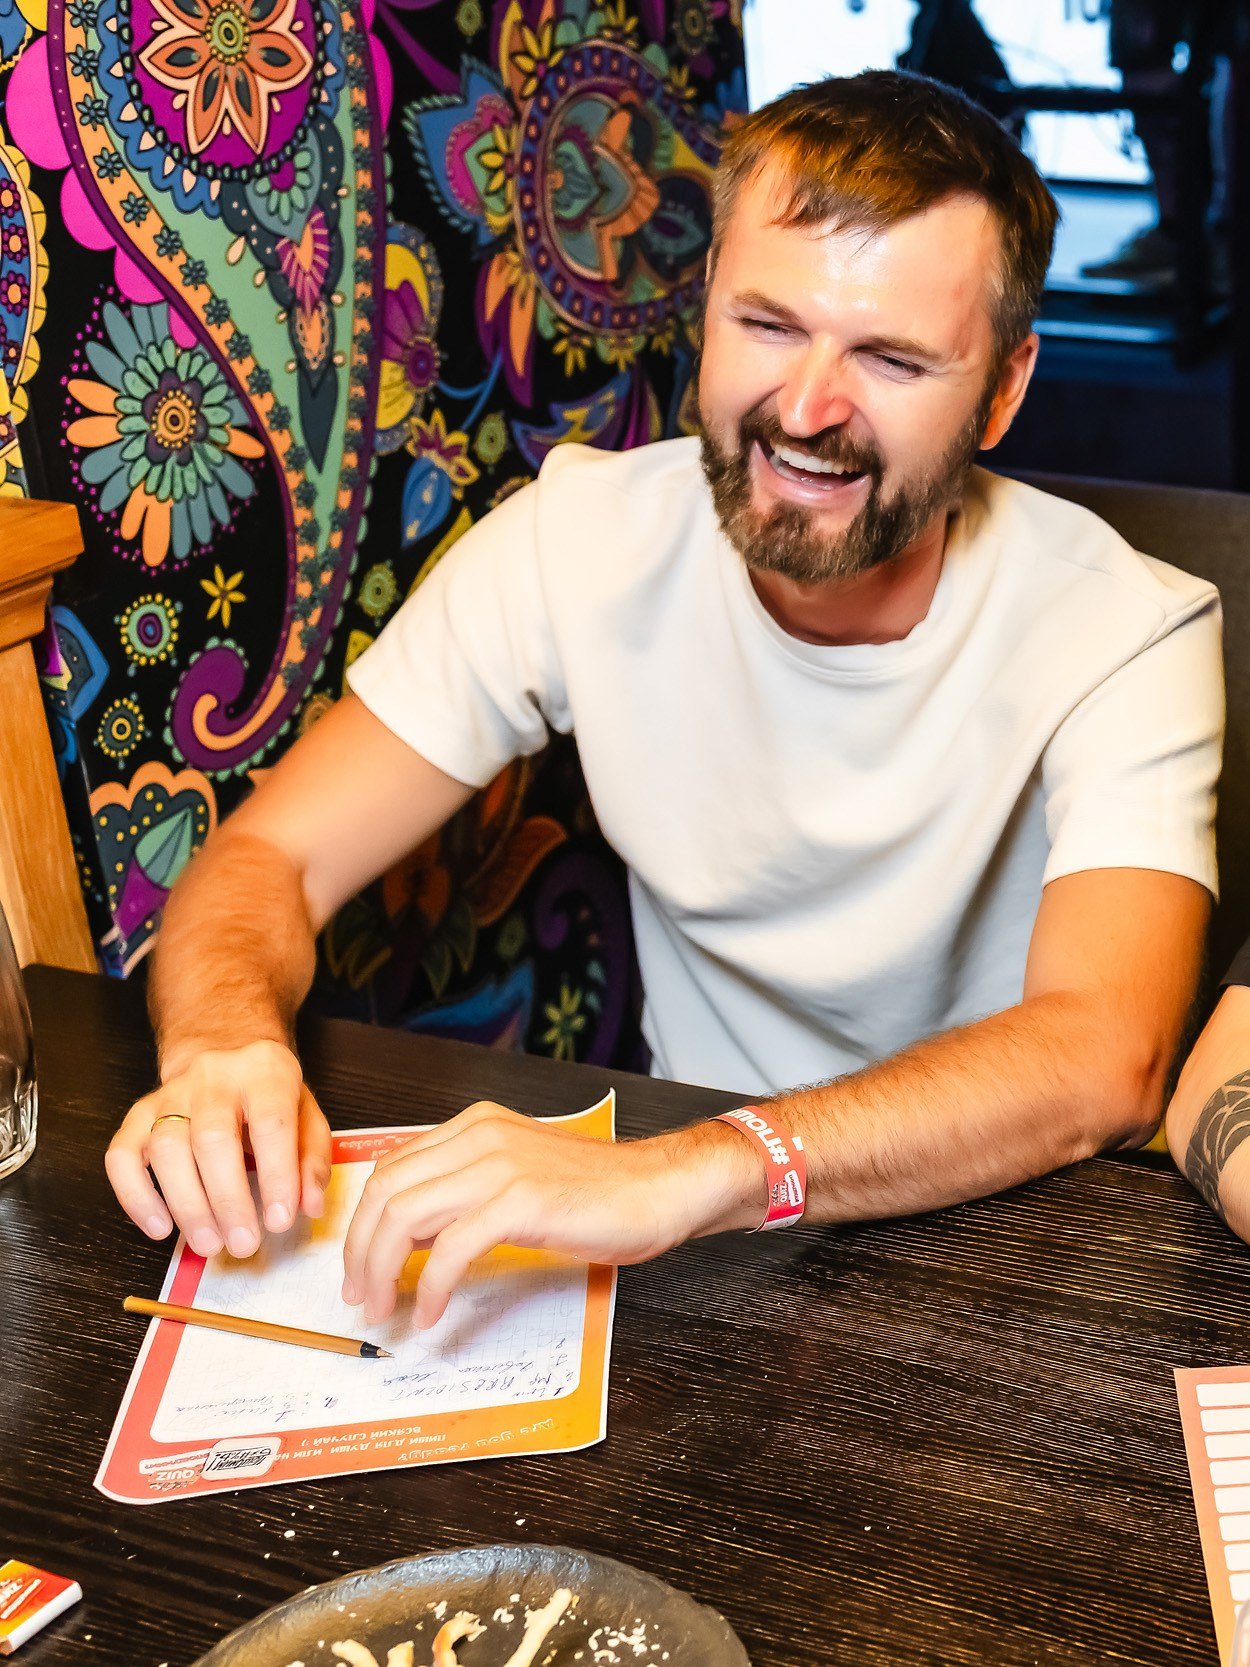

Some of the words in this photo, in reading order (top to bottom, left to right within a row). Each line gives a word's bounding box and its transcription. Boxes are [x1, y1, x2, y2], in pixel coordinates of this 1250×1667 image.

[780, 1182, 788, 1203] QUIZ
[313, 1431, 368, 1446] СЛУЧАЙ
[369, 1425, 422, 1442] ВСЯКИЙ
[409, 1433, 447, 1446] ПИШИ
[476, 1429, 515, 1449] you
[330, 1440, 371, 1455] ДУШИ
[375, 1436, 403, 1449] ДЛЯ
[293, 1447, 324, 1460] ИЛИ
[397, 1442, 470, 1461] ready?
[155, 1469, 195, 1482] QUIZ
